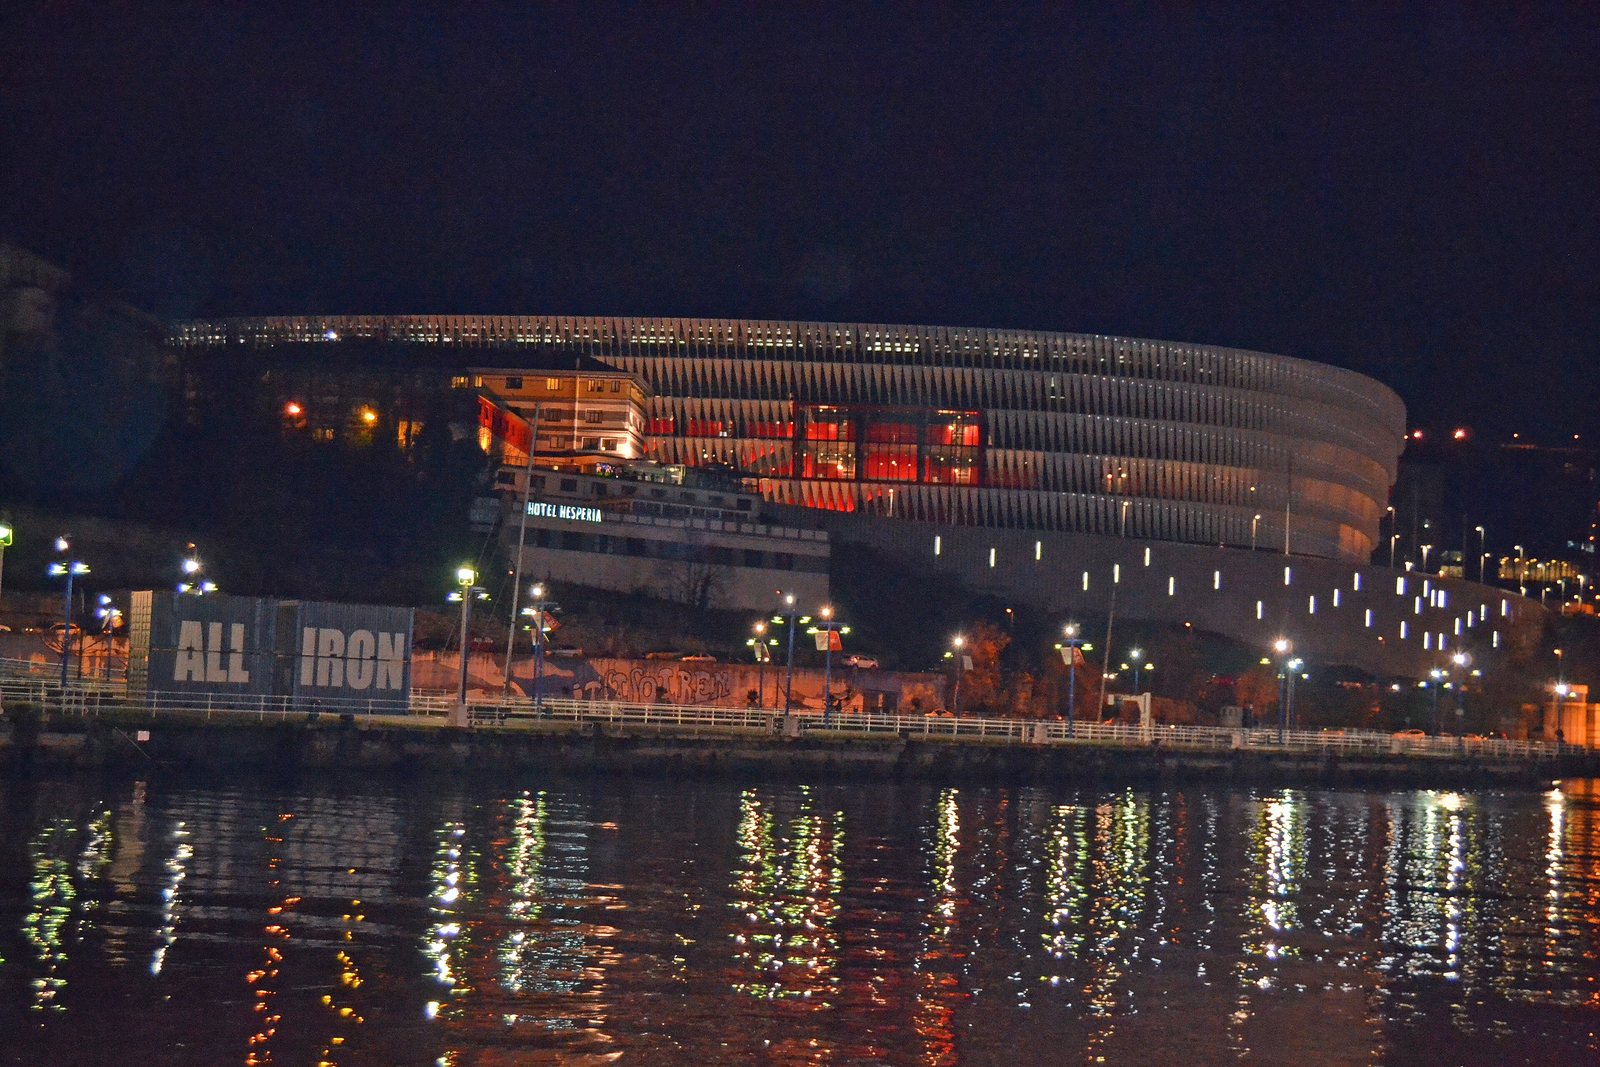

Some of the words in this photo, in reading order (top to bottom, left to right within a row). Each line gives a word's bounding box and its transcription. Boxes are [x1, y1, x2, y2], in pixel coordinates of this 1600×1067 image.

[527, 501, 557, 518] HOTEL
[559, 505, 602, 523] HESPERIA
[174, 620, 250, 683] ALL
[300, 627, 405, 690] IRON
